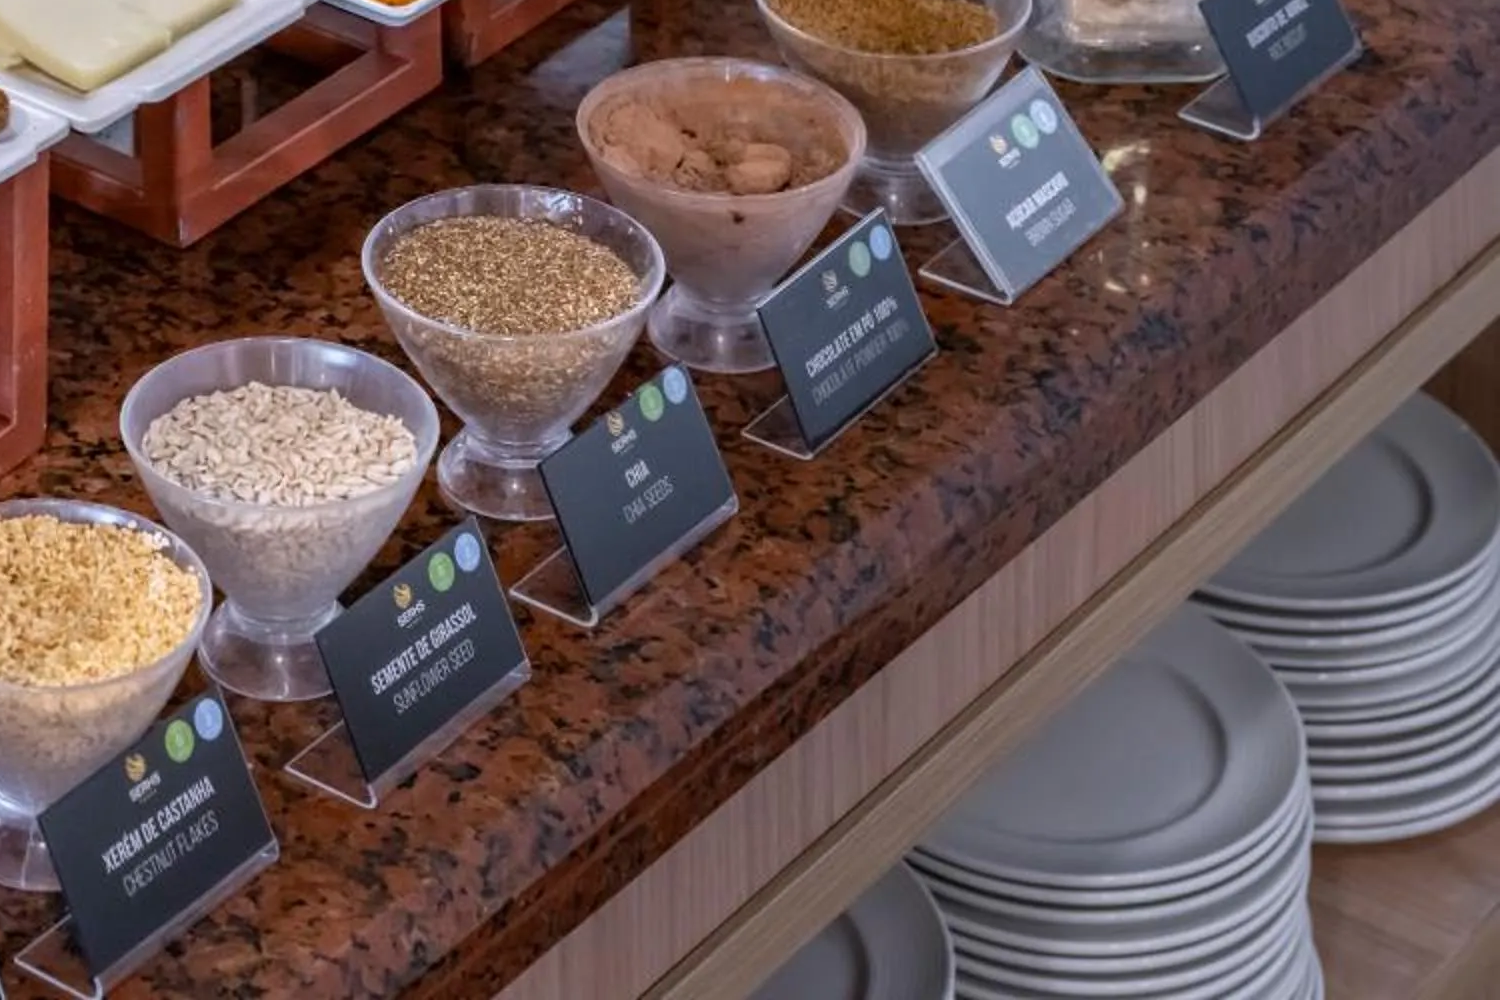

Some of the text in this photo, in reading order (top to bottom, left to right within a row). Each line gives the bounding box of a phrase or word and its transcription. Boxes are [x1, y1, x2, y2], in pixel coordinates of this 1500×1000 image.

[804, 331, 851, 378] CHOCOLATE
[848, 321, 864, 343] EM
[622, 475, 673, 524] CHIA SEEDS
[624, 459, 650, 489] CHIA
[369, 601, 476, 695] SEMENTE DE GIRASSOL
[392, 637, 476, 715] SUNFLOWER SEED
[100, 774, 215, 873] XERÉM DE CASTANHA
[122, 809, 219, 897] CHESTNUT FLAKES
